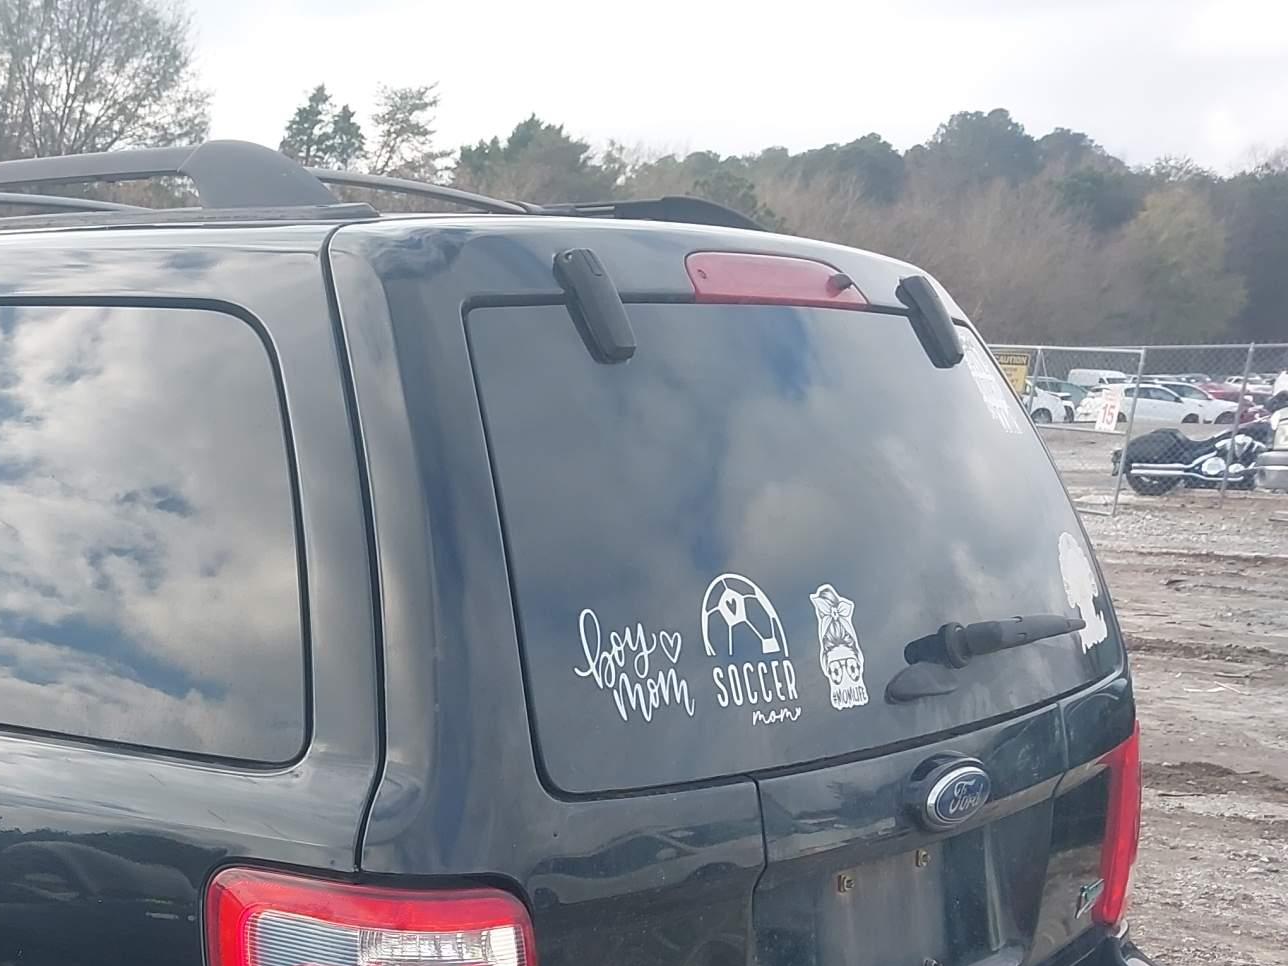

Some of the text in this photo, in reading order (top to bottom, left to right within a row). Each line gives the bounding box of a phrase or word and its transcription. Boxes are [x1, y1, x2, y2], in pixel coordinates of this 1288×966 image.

[574, 608, 657, 689] boy
[713, 659, 798, 707] SOCCER
[832, 686, 868, 706] #MOMLIFE
[752, 706, 797, 726] mom
[949, 779, 985, 815] Ford
